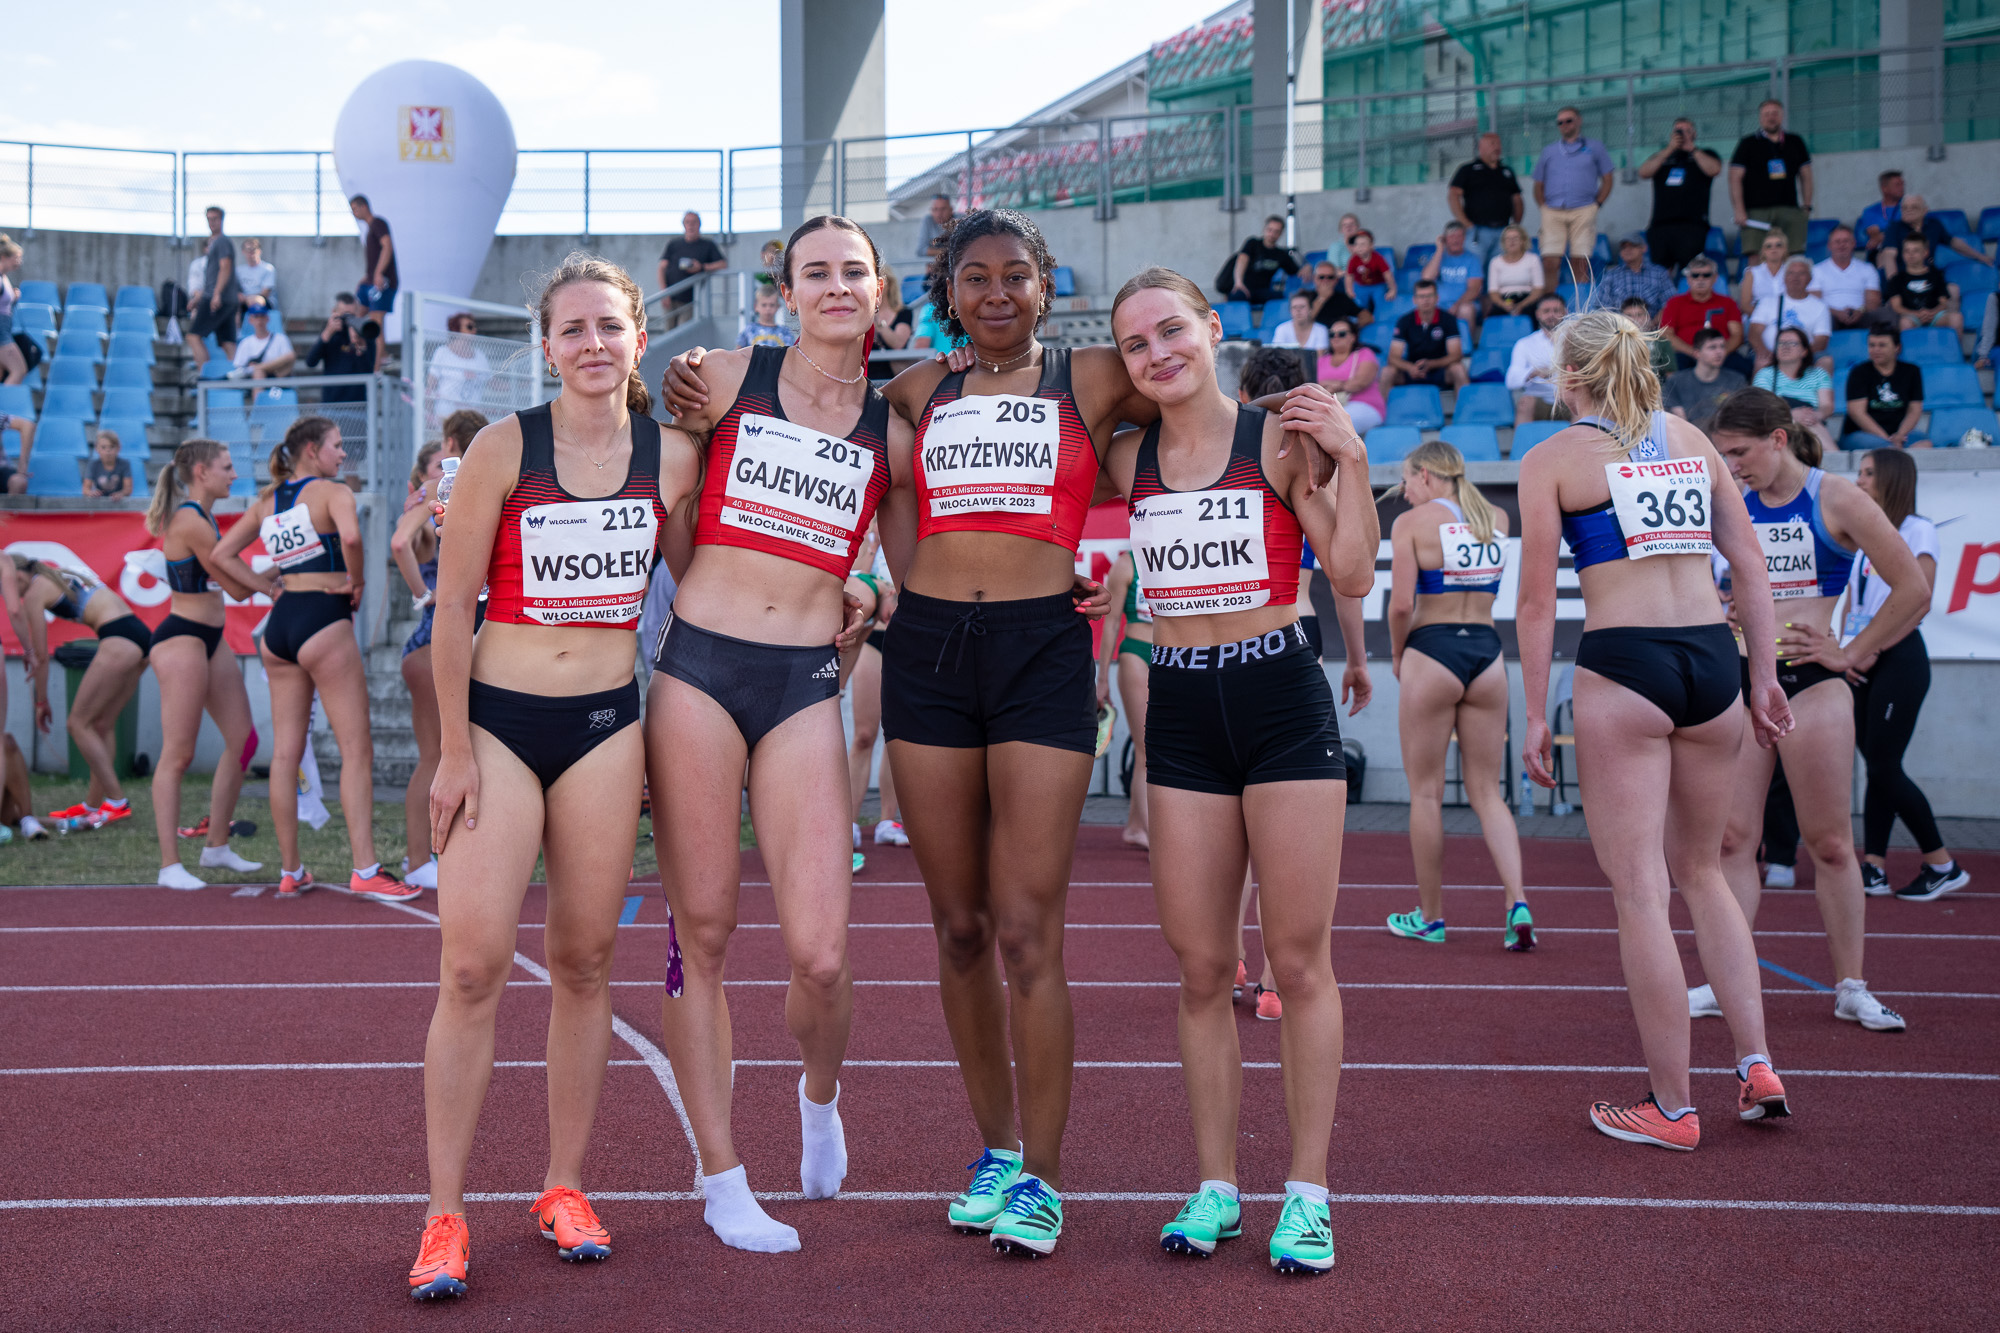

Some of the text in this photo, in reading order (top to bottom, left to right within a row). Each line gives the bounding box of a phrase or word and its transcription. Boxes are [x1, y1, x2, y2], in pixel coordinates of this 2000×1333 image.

[996, 400, 1046, 424] 205
[765, 430, 802, 443] WŁOCŁAWEK
[815, 438, 862, 470] 201
[925, 436, 1053, 473] KRZYŻEWSKA
[735, 457, 857, 515] GAJEWSKA
[942, 488, 958, 496] PZLA
[958, 485, 1005, 494] Mistrzostwa
[1006, 485, 1030, 493] Polski
[1030, 486, 1045, 494] U23
[1669, 477, 1706, 485] GROUP
[939, 497, 1036, 510] WŁOCŁAWEK 2023
[1149, 508, 1183, 517] WŁOCŁAWEK
[1198, 497, 1250, 522] 211
[1637, 488, 1705, 528] 363
[549, 518, 588, 526] WŁOCŁAWEK
[601, 506, 648, 532] 212
[732, 499, 847, 538] 40. PZLA Mistrzostwa Polski U23
[738, 513, 836, 548] WŁOCŁAWEK 2023
[269, 525, 306, 554] 285
[1633, 535, 1645, 543] 40.
[1645, 533, 1661, 541] PZLA
[1643, 542, 1697, 552] WŁOCŁAWEK
[1769, 527, 1804, 543] 354
[530, 548, 650, 582] WSOŁEK
[1141, 538, 1254, 573] WÓJCIK
[1457, 542, 1501, 568] 370
[532, 599, 547, 607] 40.
[547, 598, 567, 607] PZLA
[568, 597, 617, 607] Mistrzostwa
[618, 594, 637, 603] Polski
[1170, 587, 1217, 597] Mistrzostwa
[1218, 583, 1243, 593] Polski
[1243, 581, 1260, 591] U23
[542, 608, 620, 621] WŁOCŁAWEK
[1155, 595, 1252, 611] WŁOCŁAWEK 2023
[1217, 629, 1286, 669] PRO
